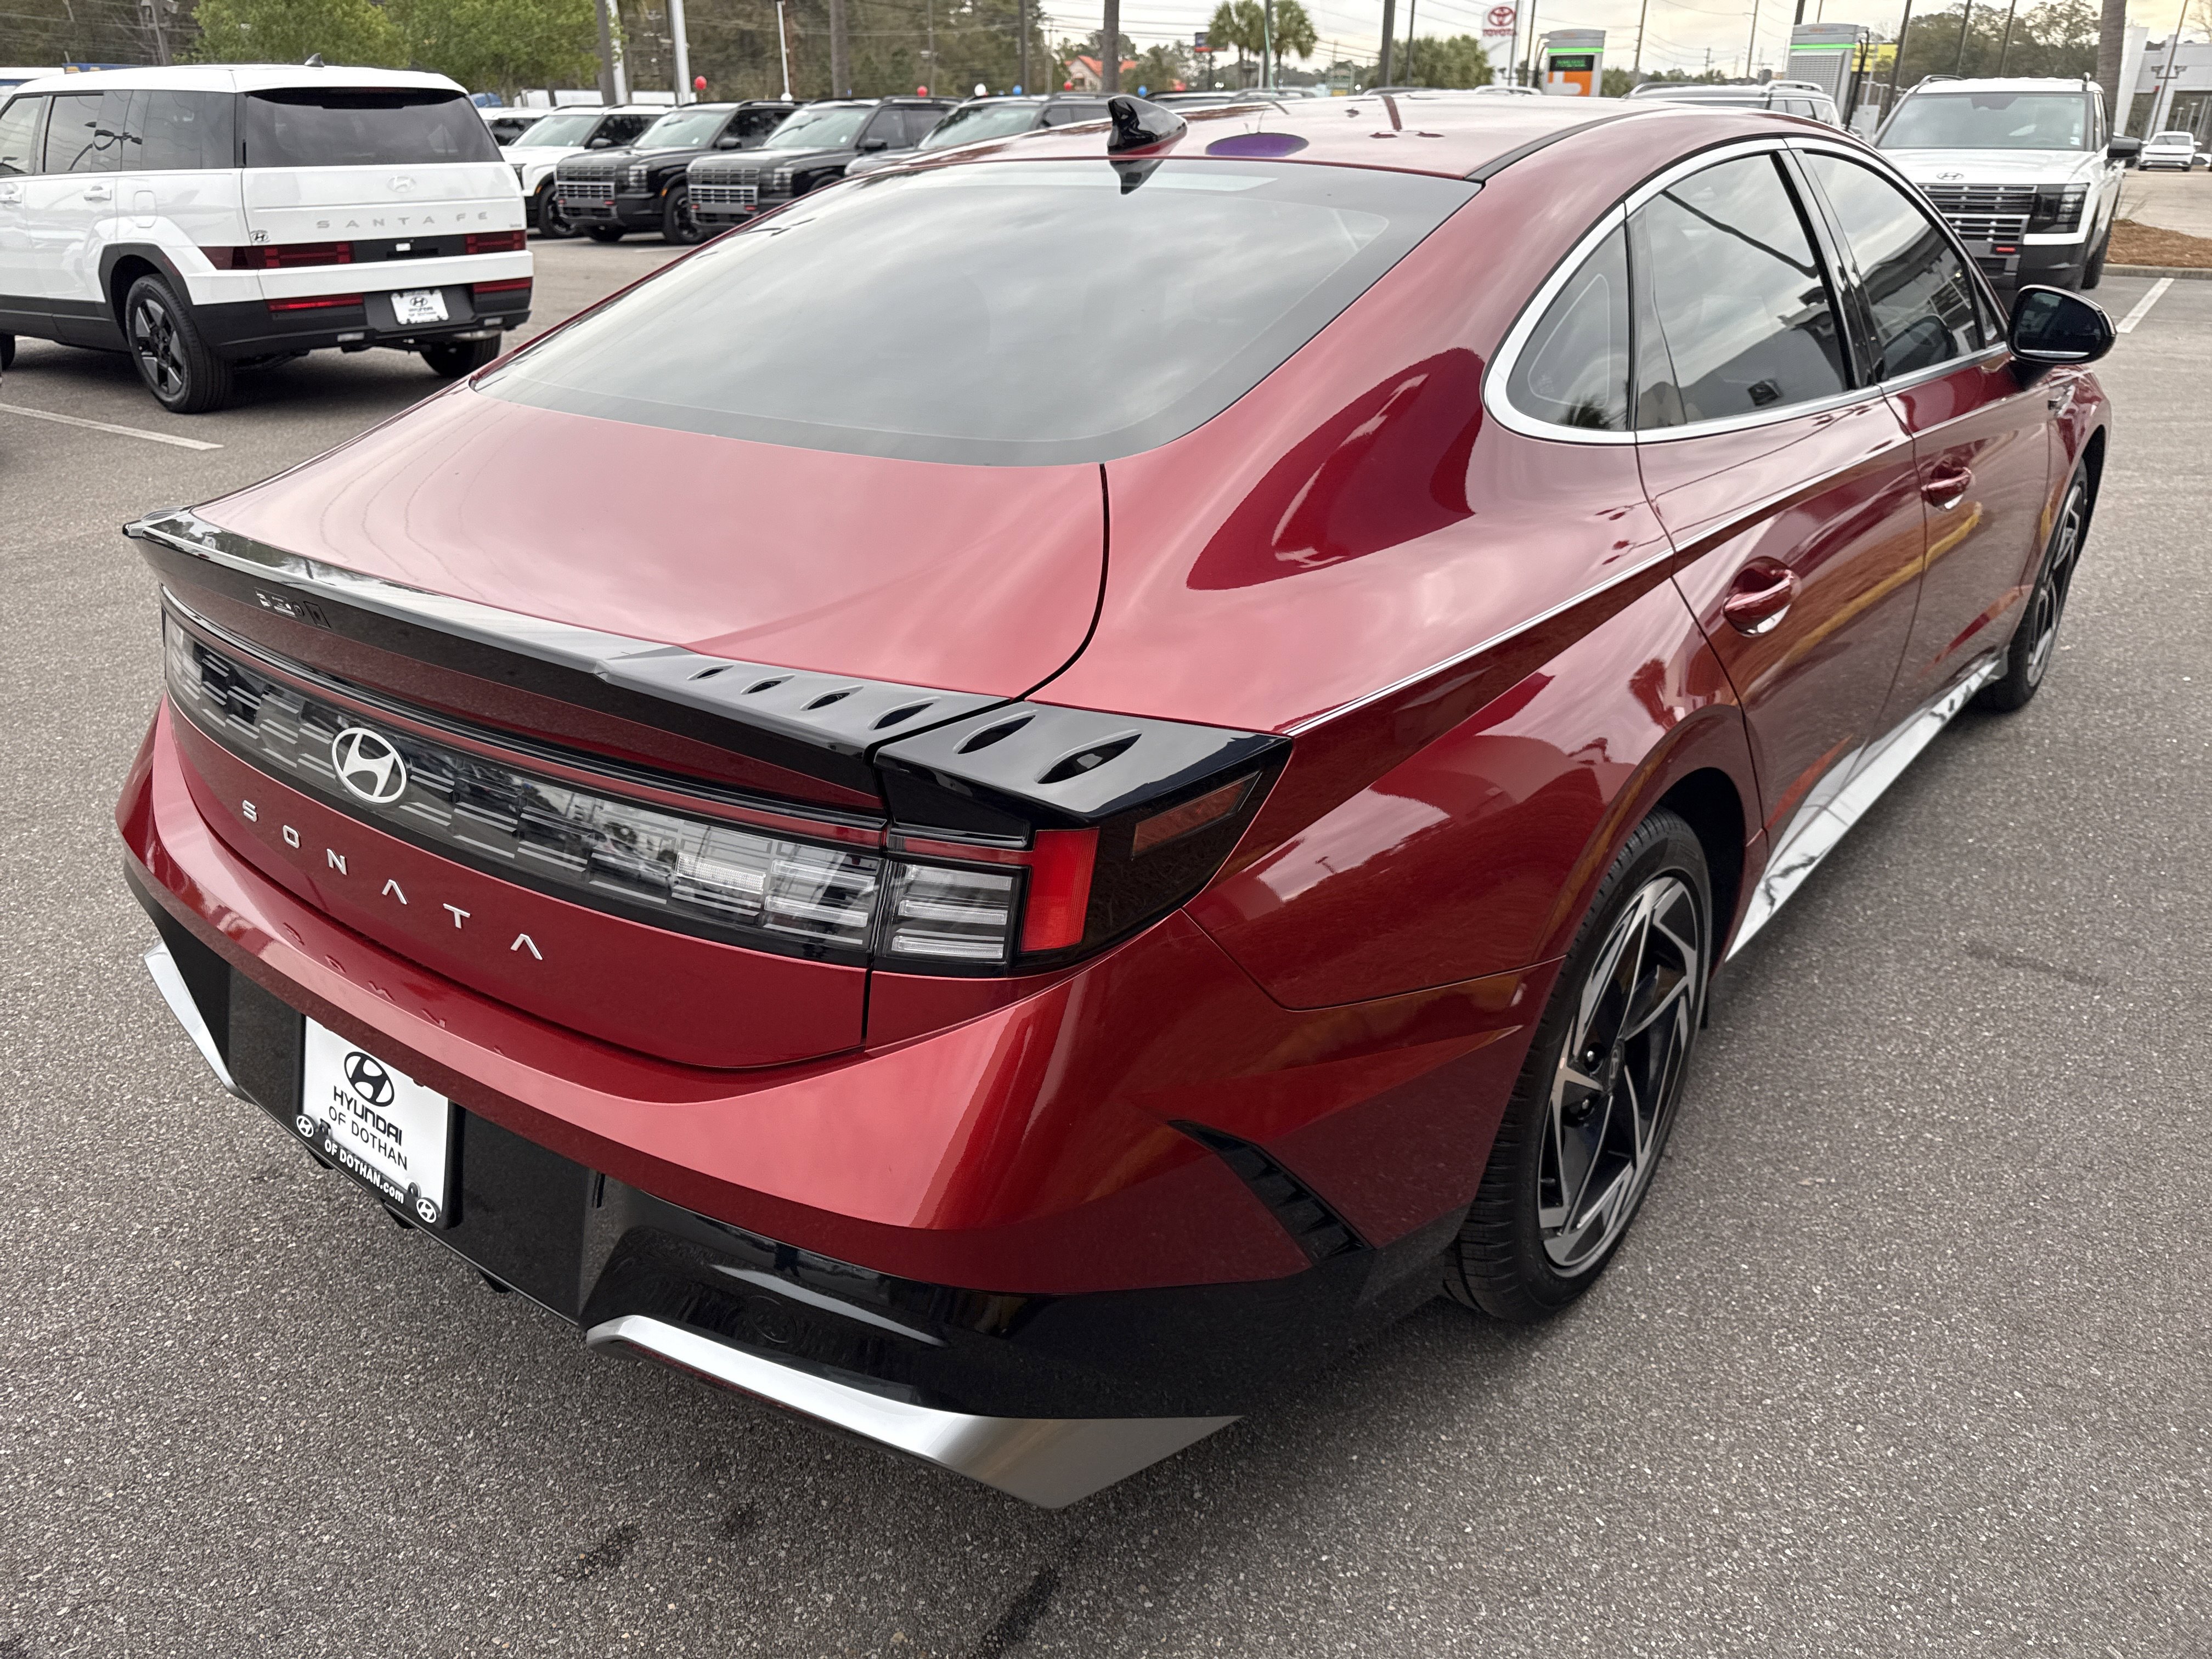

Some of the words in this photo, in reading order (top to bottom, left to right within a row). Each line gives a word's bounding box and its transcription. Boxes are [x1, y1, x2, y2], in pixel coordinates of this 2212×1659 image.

[317, 216, 435, 229] SANTA
[456, 212, 488, 222] FE
[242, 799, 543, 960] SONATA
[329, 1106, 346, 1125] OF
[352, 1120, 408, 1170] DOTHAN
[334, 1085, 402, 1146] HYUNDAI
[325, 1139, 338, 1155] OF
[340, 1149, 404, 1204] DOTHAN.com
